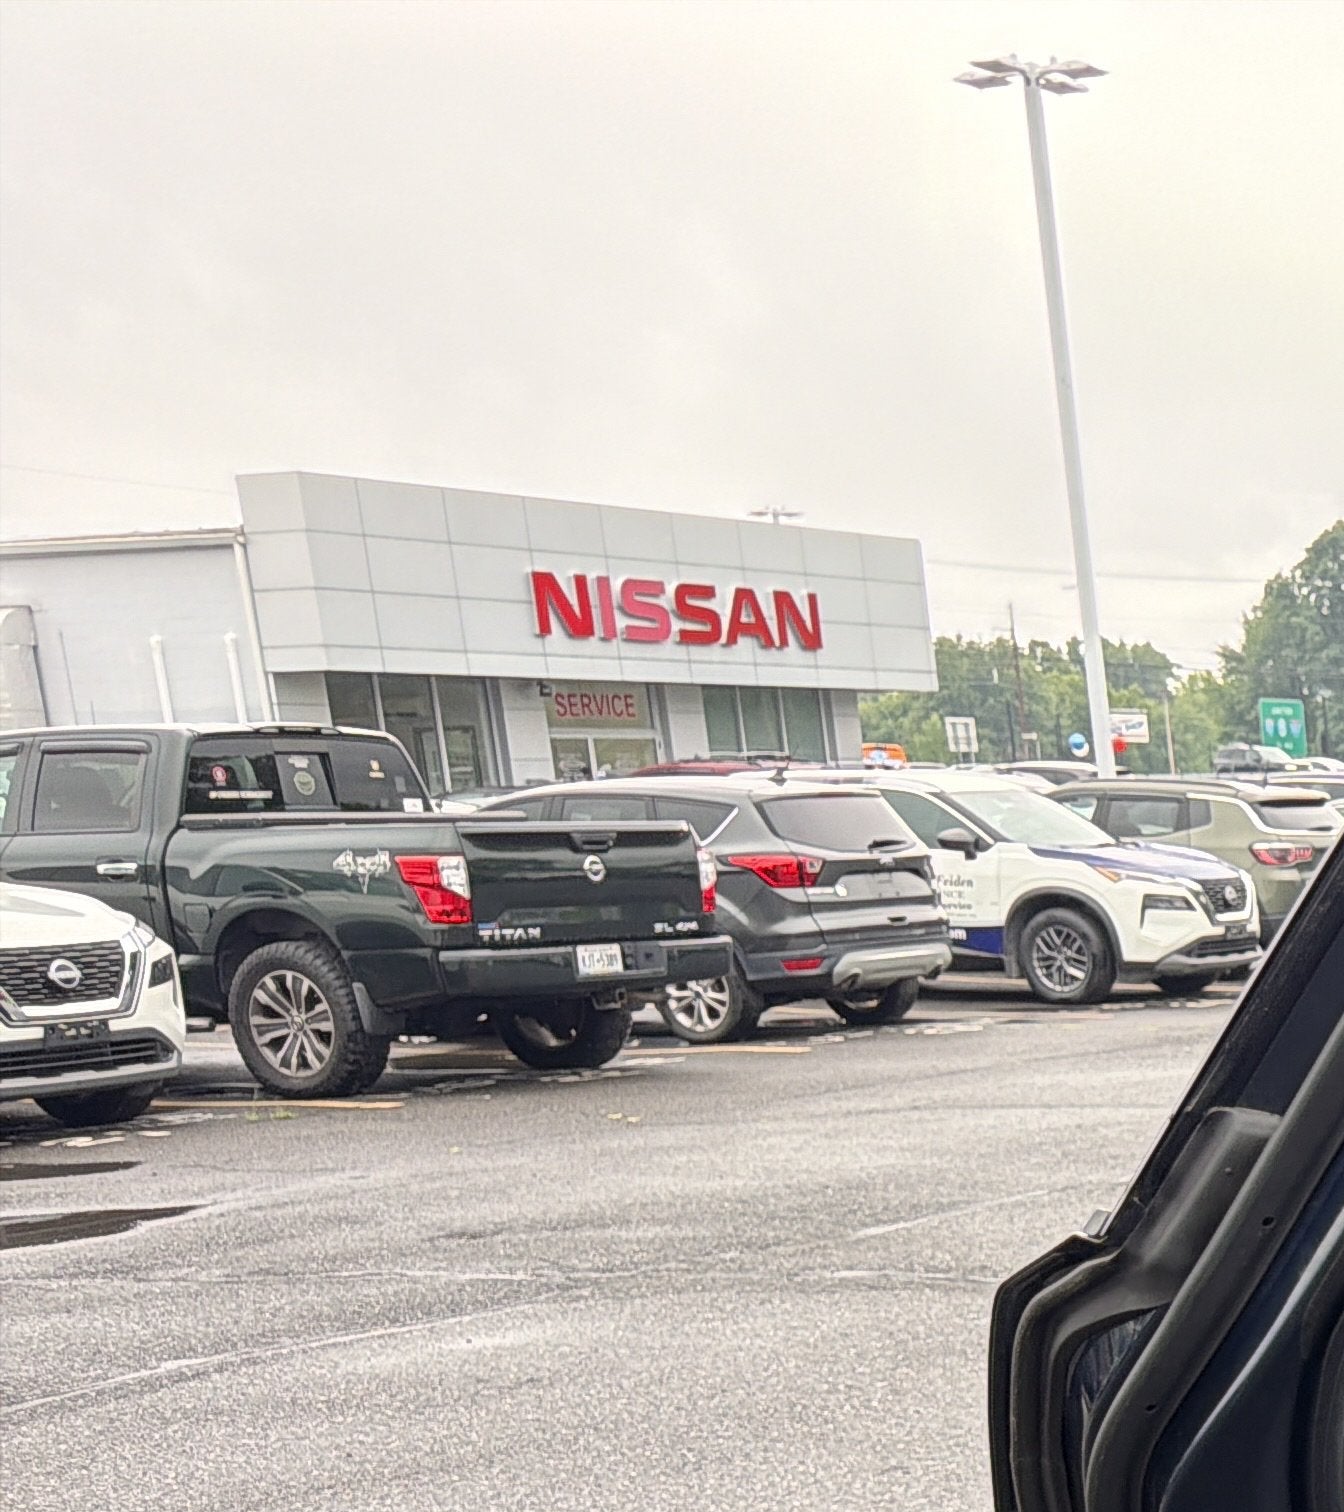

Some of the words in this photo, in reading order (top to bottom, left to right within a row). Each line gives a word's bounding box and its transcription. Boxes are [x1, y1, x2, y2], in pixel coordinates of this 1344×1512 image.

[531, 570, 824, 651] NISSAN
[554, 692, 637, 719] SERVICE
[478, 926, 542, 943] TITAN
